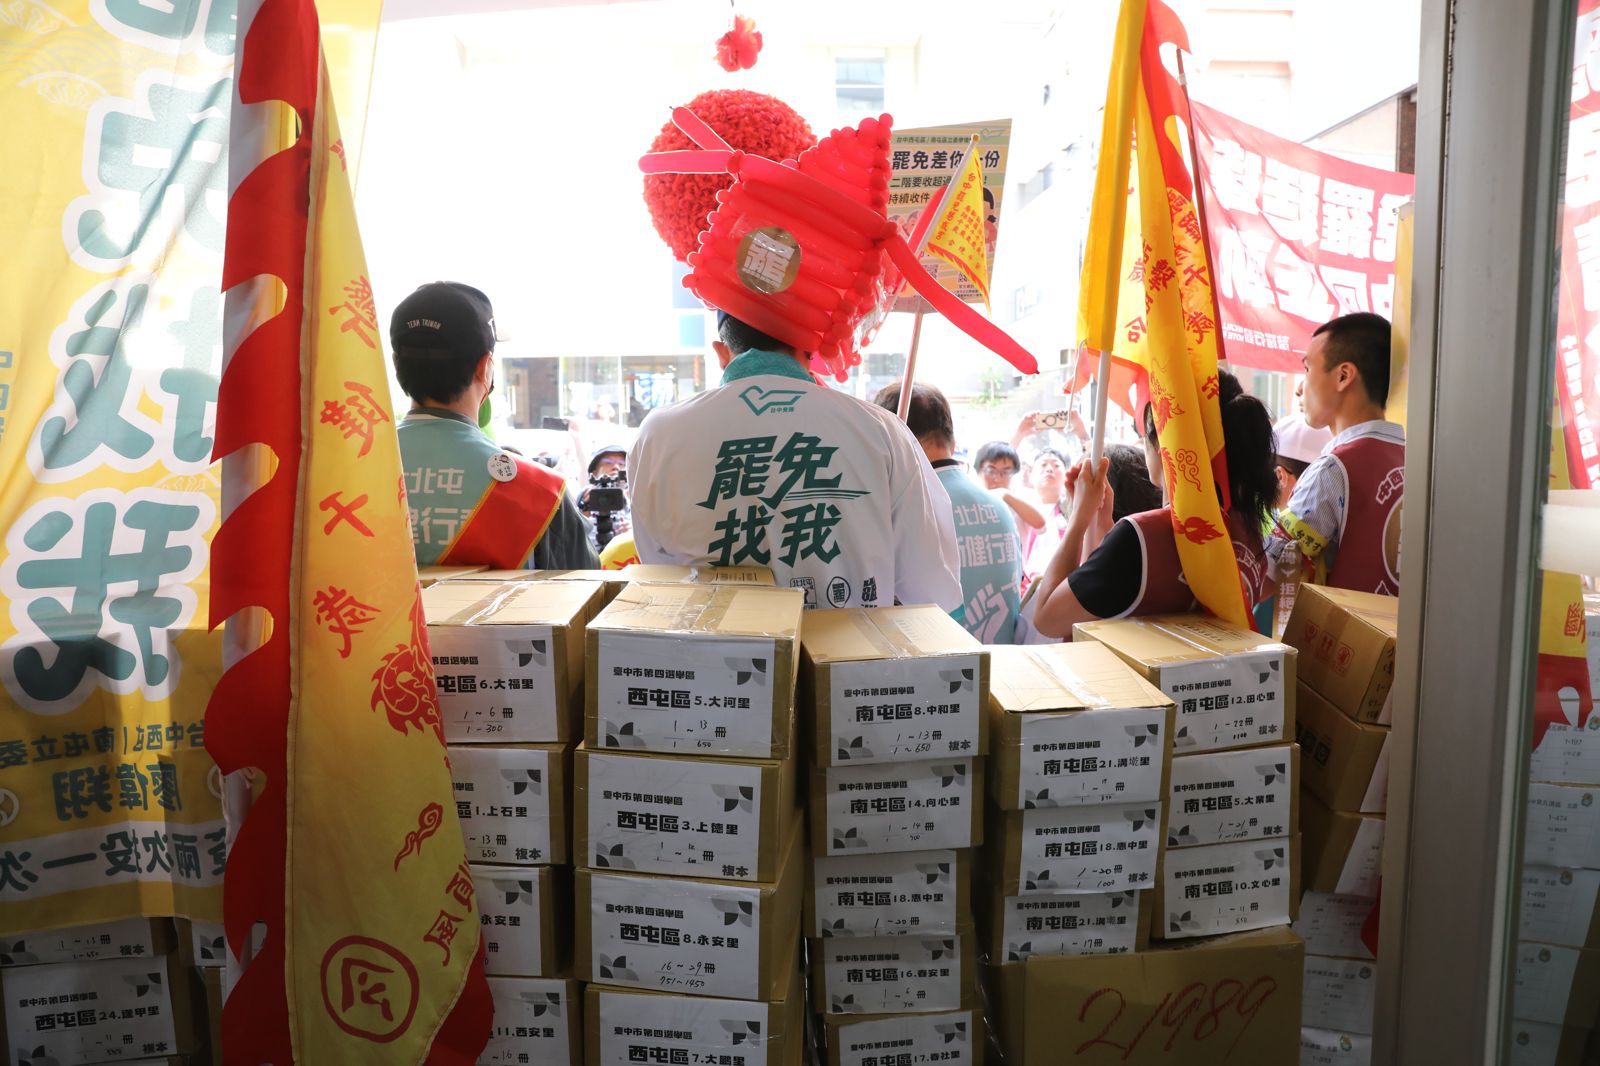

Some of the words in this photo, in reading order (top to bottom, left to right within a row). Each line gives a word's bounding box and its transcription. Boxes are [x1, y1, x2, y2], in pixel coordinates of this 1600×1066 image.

[892, 150, 1000, 170] 罷免差你份
[696, 432, 850, 510] 罷免
[707, 502, 842, 568] 找我
[515, 848, 542, 860] 複本
[721, 864, 749, 878] 複本
[480, 914, 521, 927] 永安里
[119, 944, 145, 956] 複本
[142, 1042, 168, 1054] 複本
